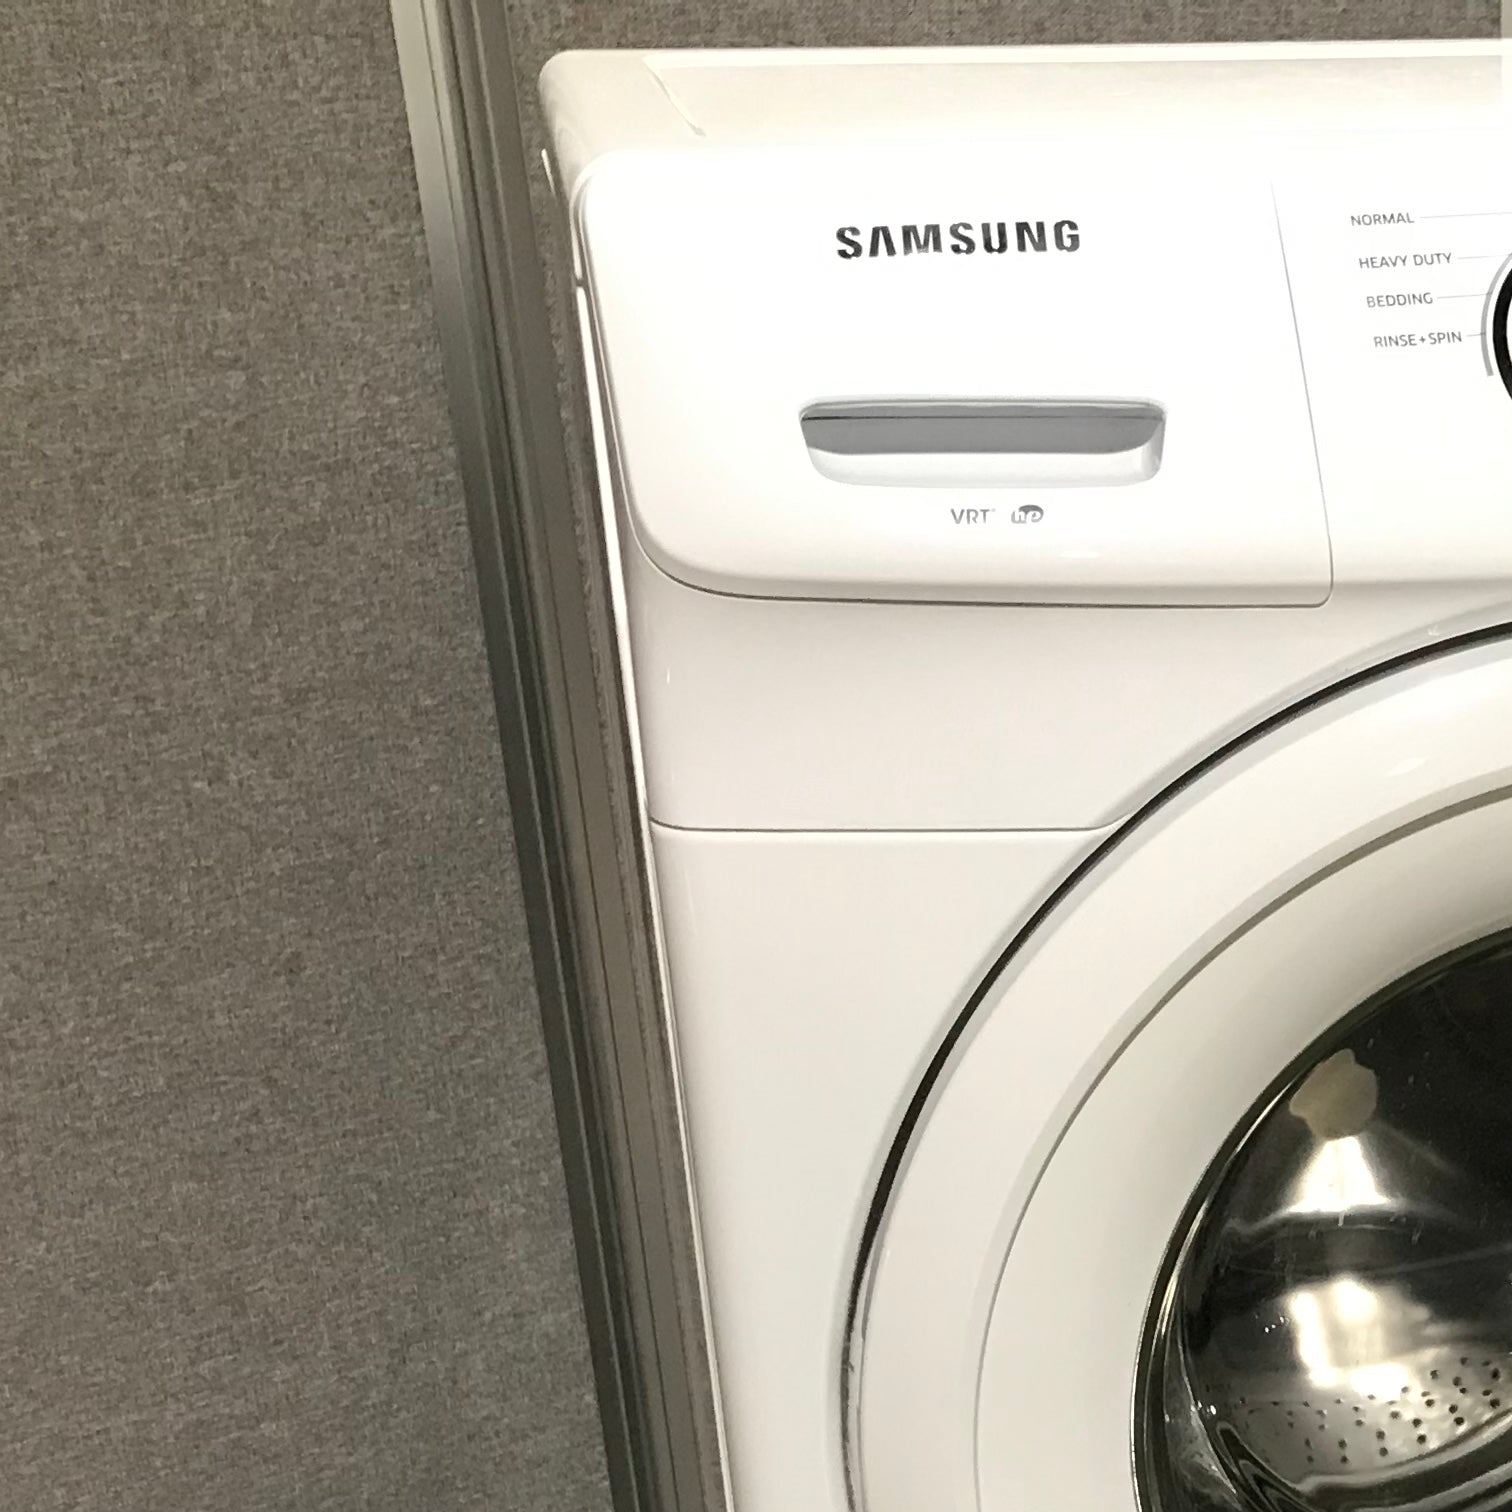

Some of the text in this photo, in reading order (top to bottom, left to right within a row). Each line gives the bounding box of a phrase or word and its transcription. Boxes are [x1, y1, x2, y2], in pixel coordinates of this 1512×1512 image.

[1350, 212, 1415, 227] NORMAL
[836, 220, 1080, 259] SAMSUNG
[1358, 252, 1453, 269] HEAVY DUTY
[1366, 292, 1434, 308] BEDDING
[1373, 331, 1463, 349] RINSE+SPIN
